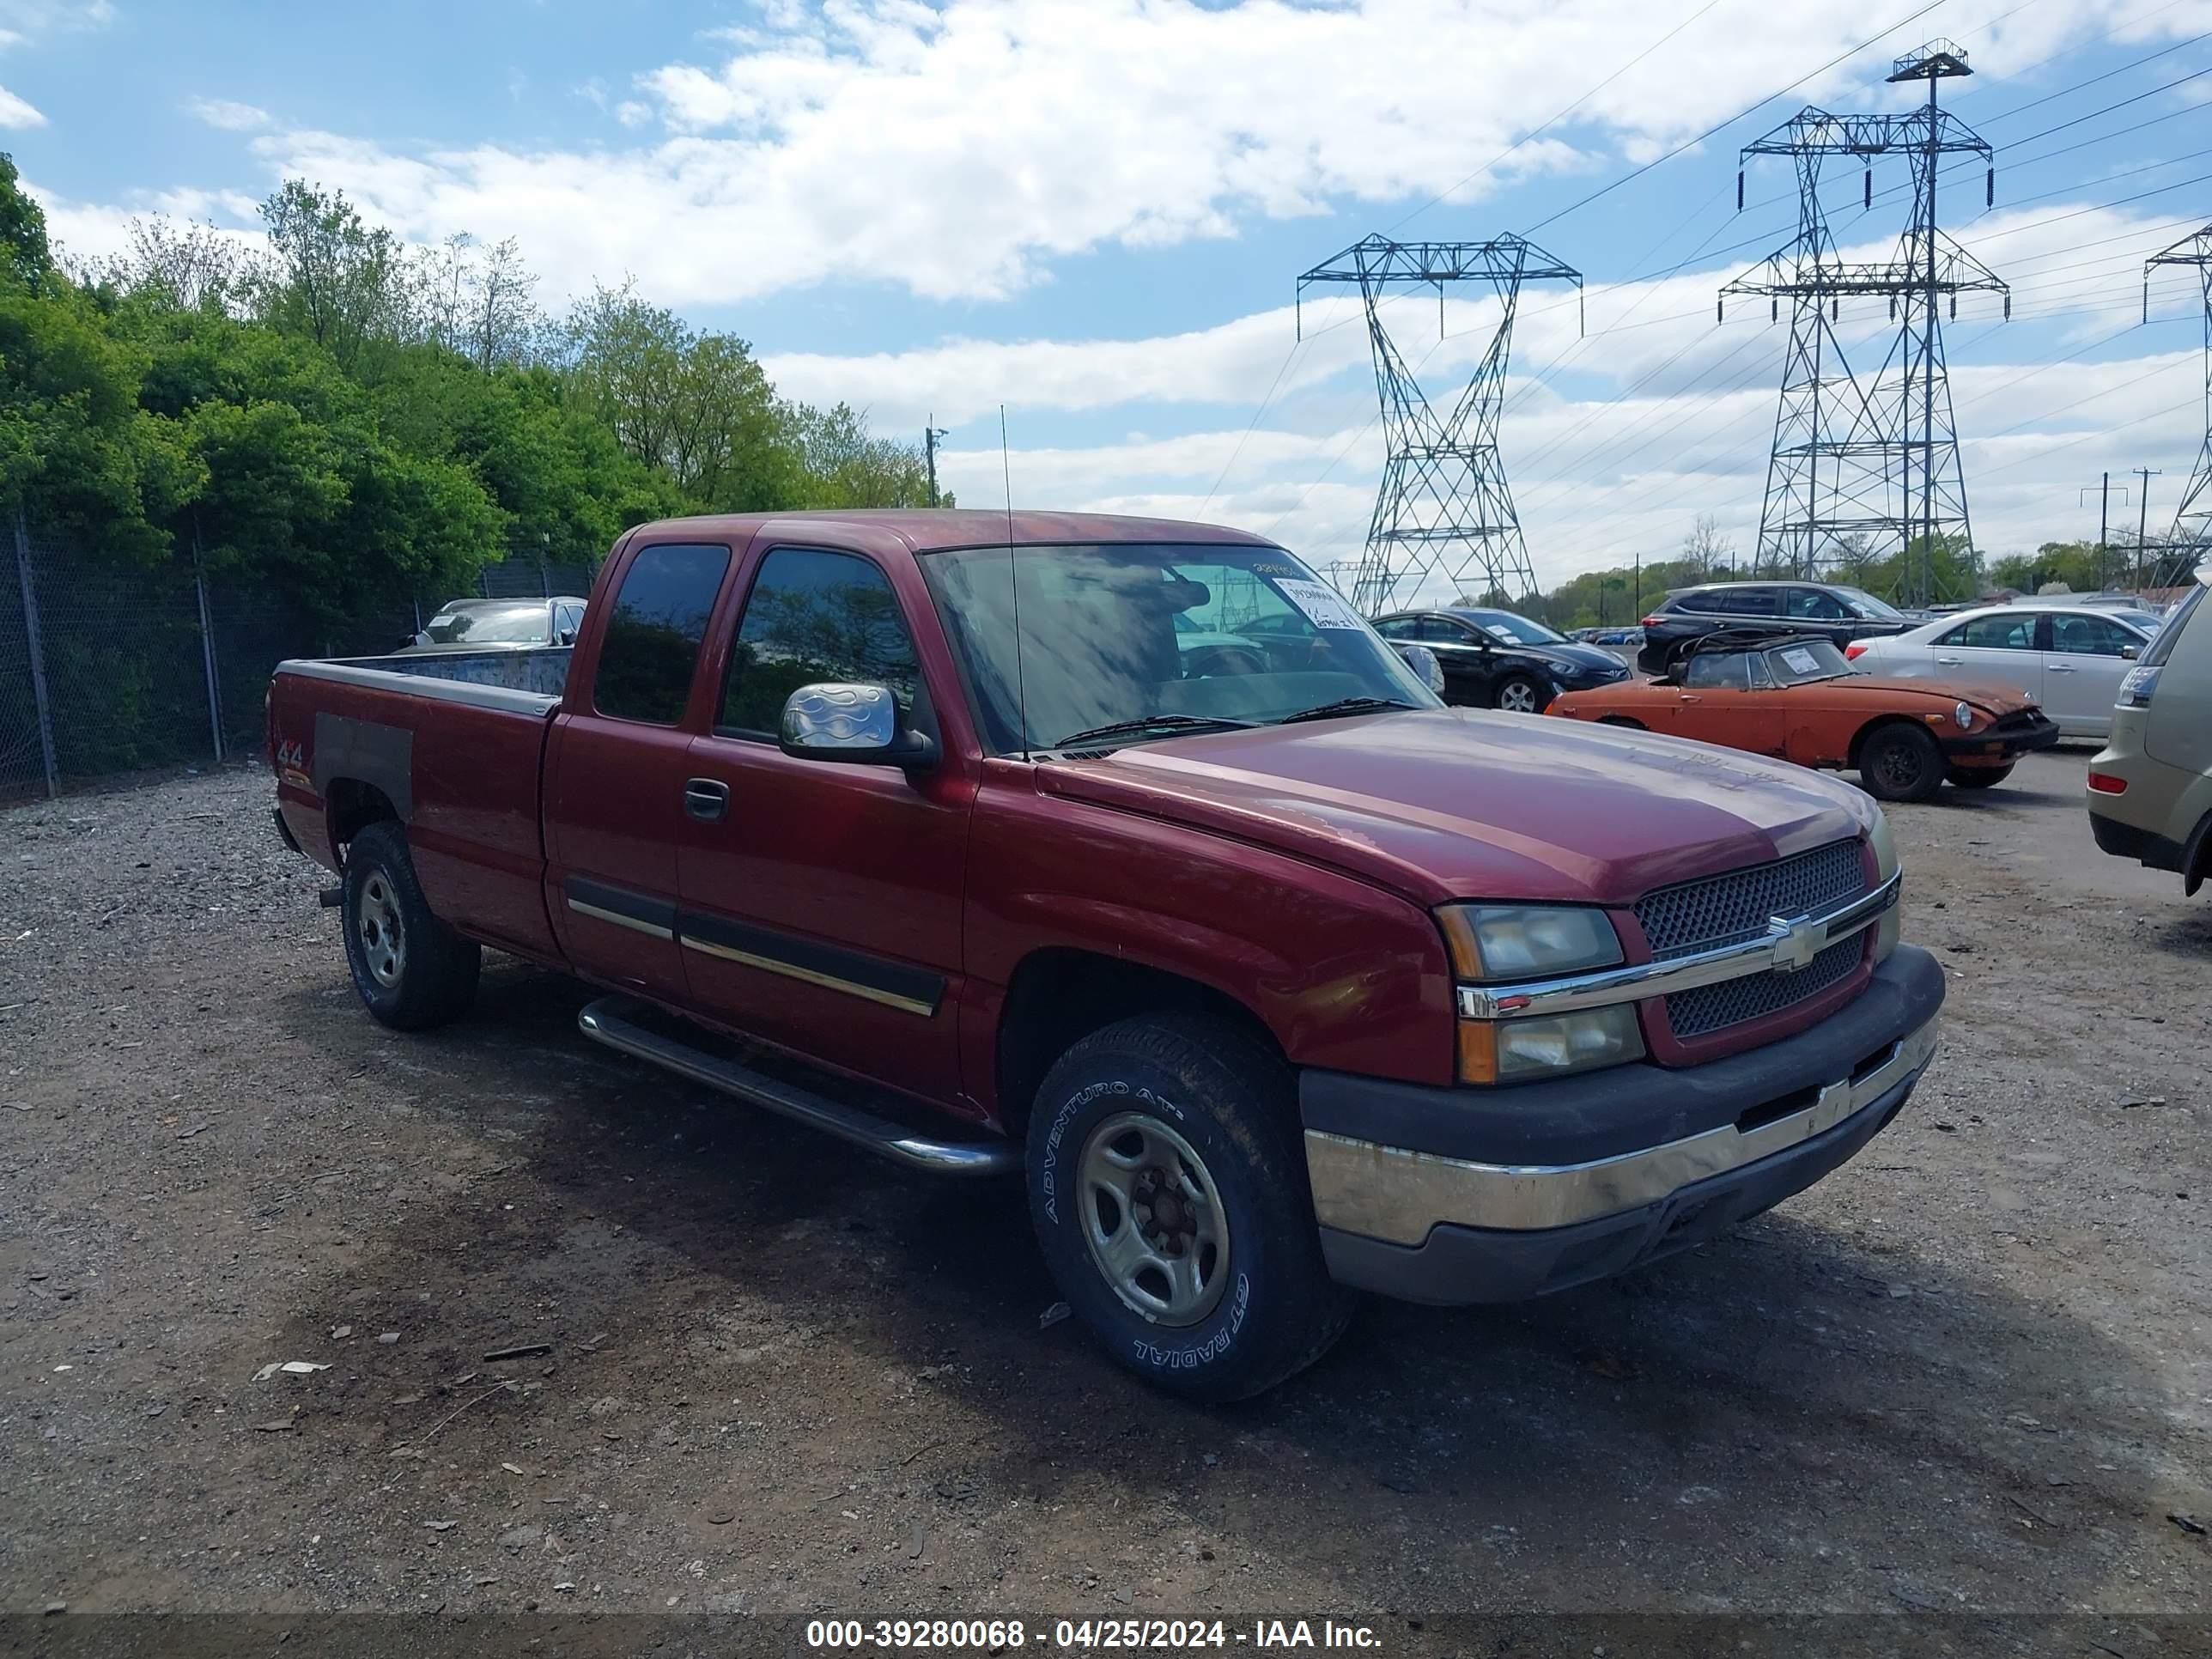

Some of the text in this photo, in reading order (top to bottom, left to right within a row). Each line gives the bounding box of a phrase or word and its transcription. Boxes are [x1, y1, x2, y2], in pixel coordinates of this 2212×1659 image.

[1043, 1080, 1130, 1224] ADVENTURO
[1133, 1273, 1250, 1368] GT RADIAL
